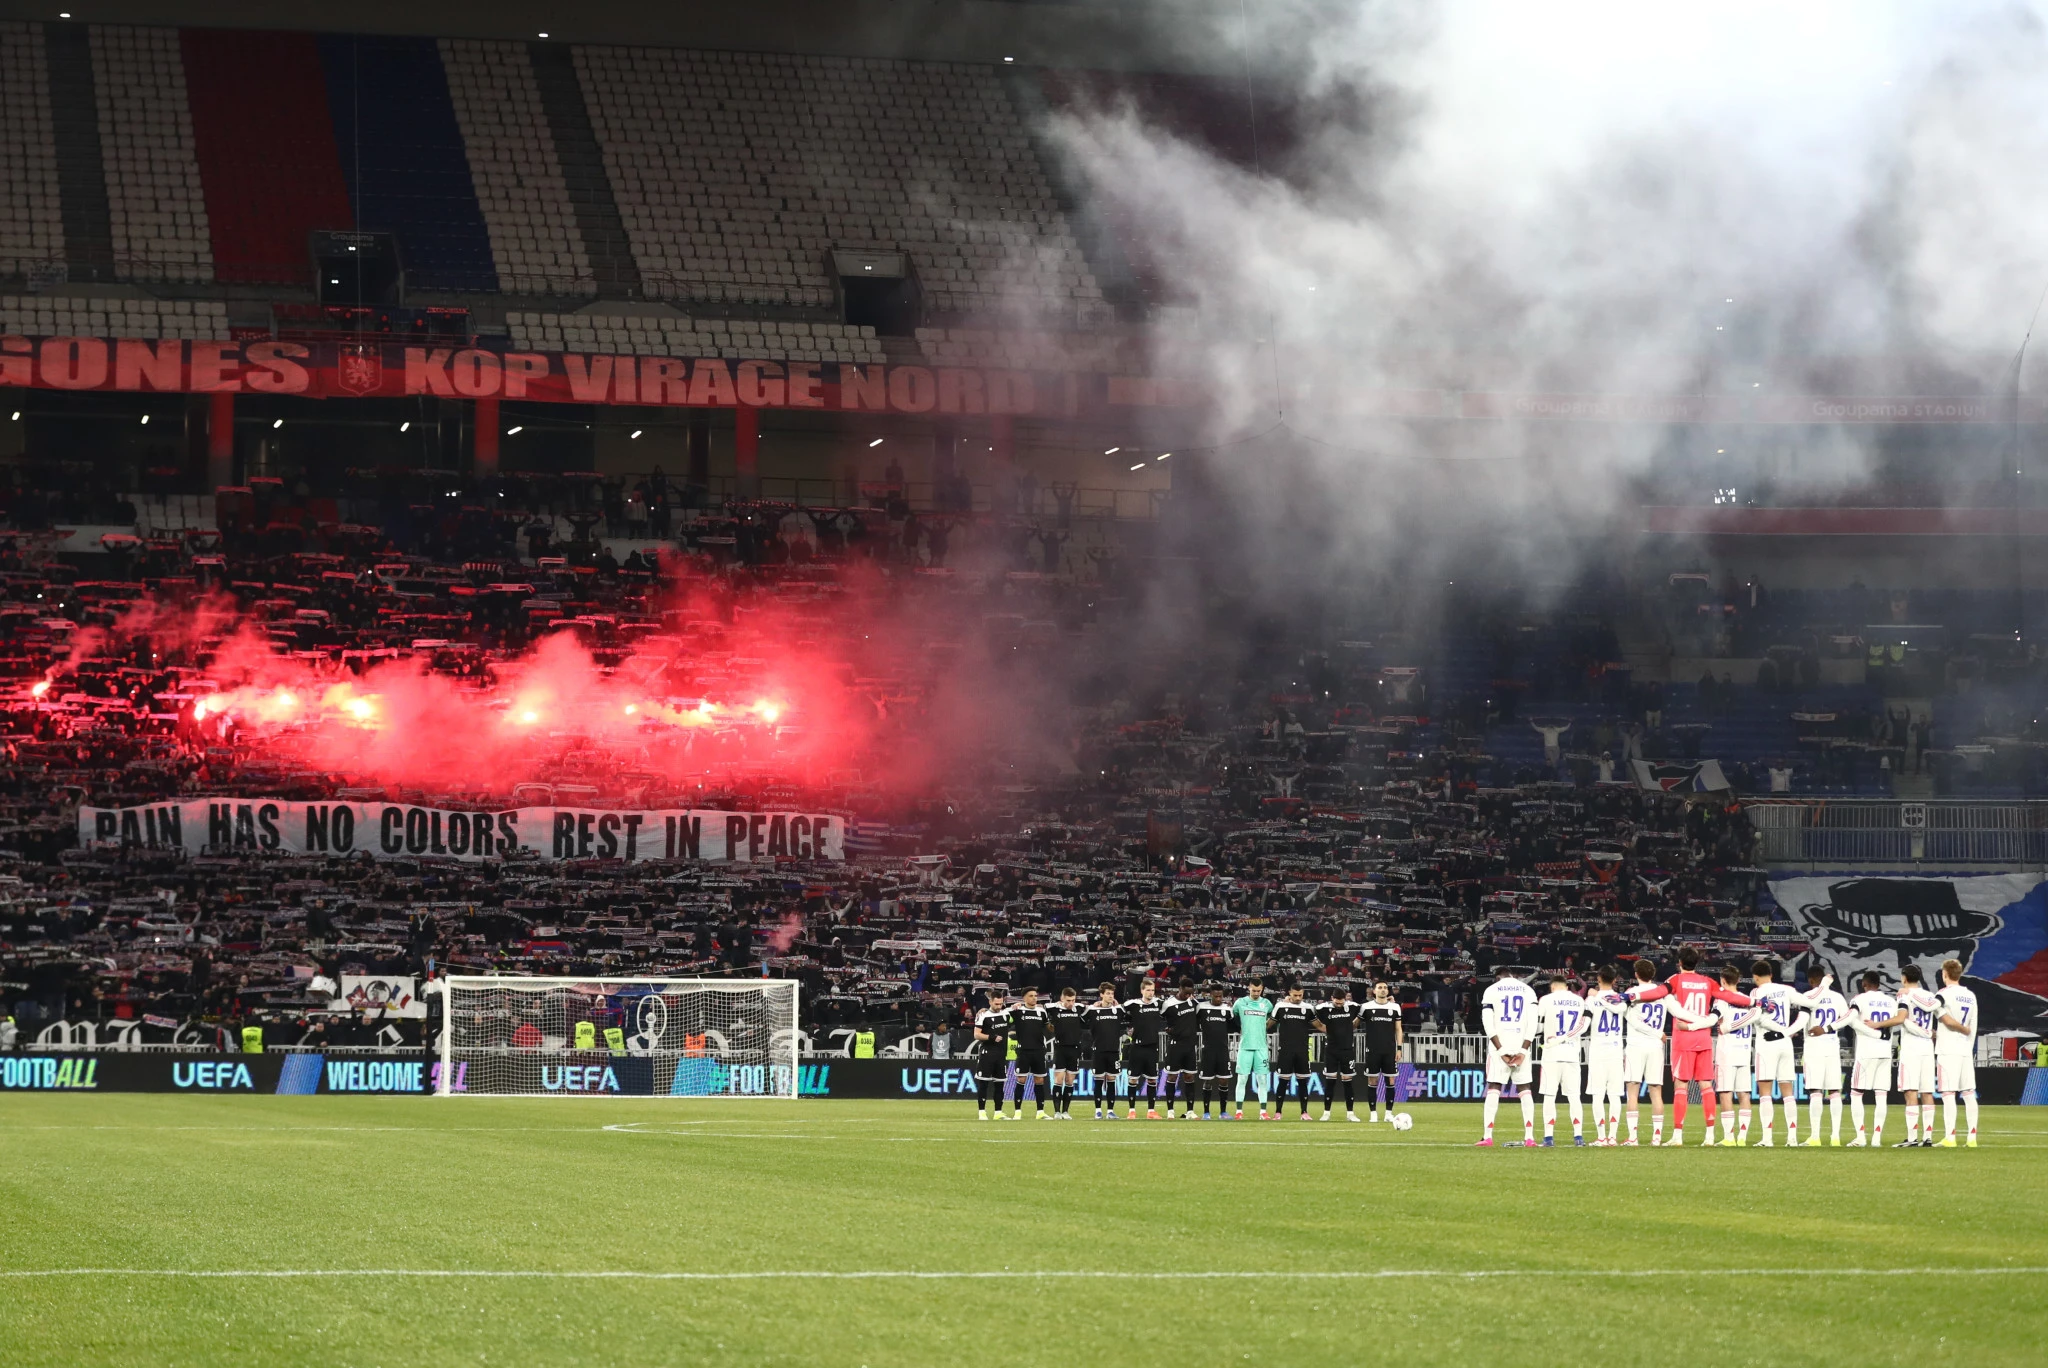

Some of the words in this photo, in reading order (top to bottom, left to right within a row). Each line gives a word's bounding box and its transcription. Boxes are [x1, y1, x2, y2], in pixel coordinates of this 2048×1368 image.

[405, 347, 549, 397] KOP
[563, 354, 824, 407] VIRAGE
[840, 363, 1035, 414] NORD
[1516, 399, 1609, 416] Groupama
[1813, 401, 1908, 418] Groupama
[1914, 404, 1986, 417] STADIUM
[95, 804, 182, 847] PAIN
[209, 803, 280, 850] HAS
[306, 804, 354, 853] NO
[380, 806, 518, 857] COLORS
[552, 811, 643, 859] REST
[665, 814, 700, 860] IN
[726, 812, 829, 860] PEACE
[1501, 995, 1524, 1022] 19
[1642, 1003, 1664, 1030] 23
[1683, 992, 1706, 1017] 40
[1961, 1006, 1969, 1026] 7
[1556, 1010, 1579, 1036] 17
[1598, 1010, 1620, 1036] 44
[1815, 1008, 1836, 1034] 22
[1913, 1006, 1931, 1030] 39
[172, 1062, 254, 1088] UEFA
[327, 1061, 424, 1091] WELCOME
[541, 1065, 620, 1092] UEFA
[902, 1068, 978, 1093] UEFA
